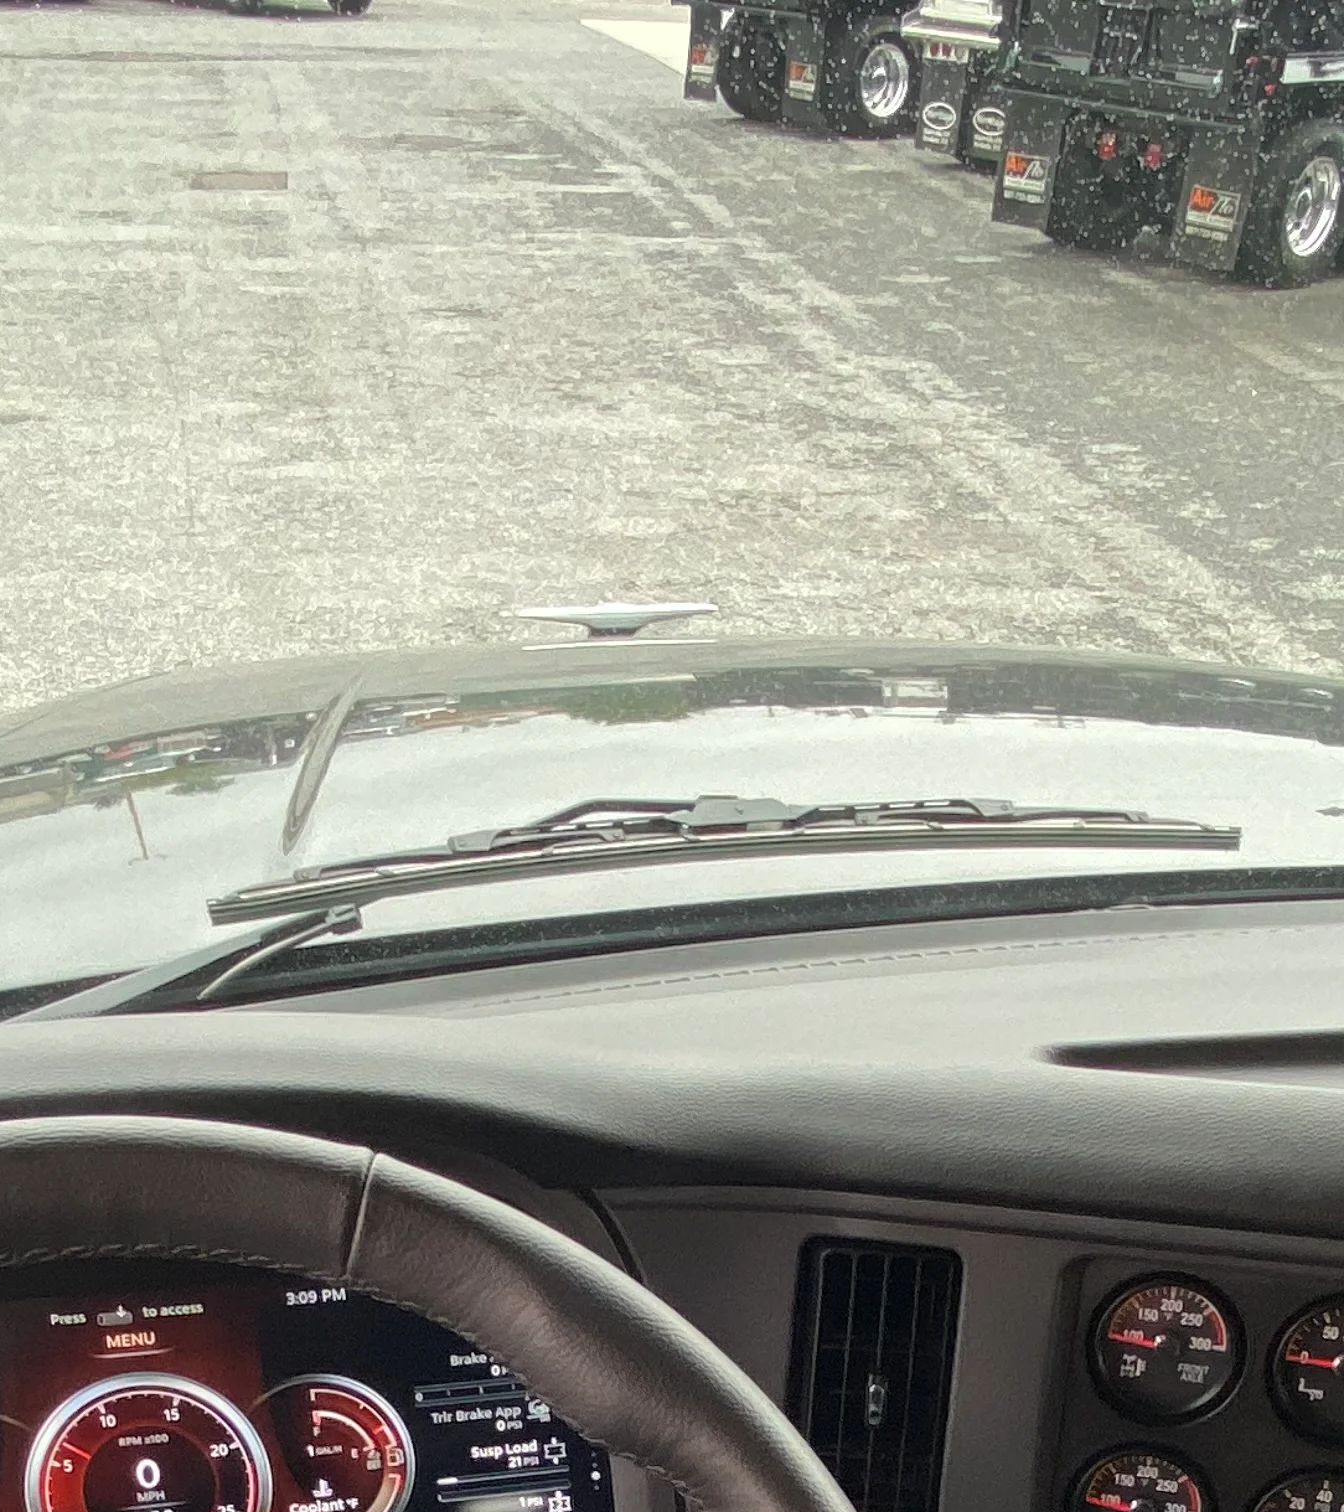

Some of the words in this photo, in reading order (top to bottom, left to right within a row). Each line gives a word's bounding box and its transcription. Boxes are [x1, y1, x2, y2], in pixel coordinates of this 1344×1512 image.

[286, 1291, 317, 1306] 3:09
[322, 1288, 346, 1302] PM
[1160, 1298, 1184, 1313] 200
[50, 1312, 86, 1326] Press
[142, 1306, 157, 1318] to
[160, 1303, 204, 1317] access
[1138, 1308, 1159, 1322] 150
[1179, 1313, 1204, 1327] 250
[106, 1332, 156, 1349] MENU
[1322, 1326, 1340, 1341] 50
[1188, 1336, 1212, 1350] 300
[450, 1352, 487, 1366] Brake
[100, 1415, 117, 1428] 10
[163, 1409, 180, 1421] 15
[455, 1408, 493, 1422] Brake
[495, 1406, 522, 1420] App
[118, 1436, 143, 1447] RPM
[210, 1445, 230, 1458] 20
[470, 1445, 504, 1460] Susp
[506, 1440, 538, 1454] Load
[64, 1460, 73, 1473] 5
[136, 1458, 160, 1489] 0
[1136, 1465, 1158, 1479] 200
[1115, 1473, 1135, 1487] 150
[1155, 1479, 1178, 1494] 250
[136, 1490, 166, 1502] MPH
[1289, 1496, 1305, 1511] 20
[1316, 1490, 1333, 1503] 40
